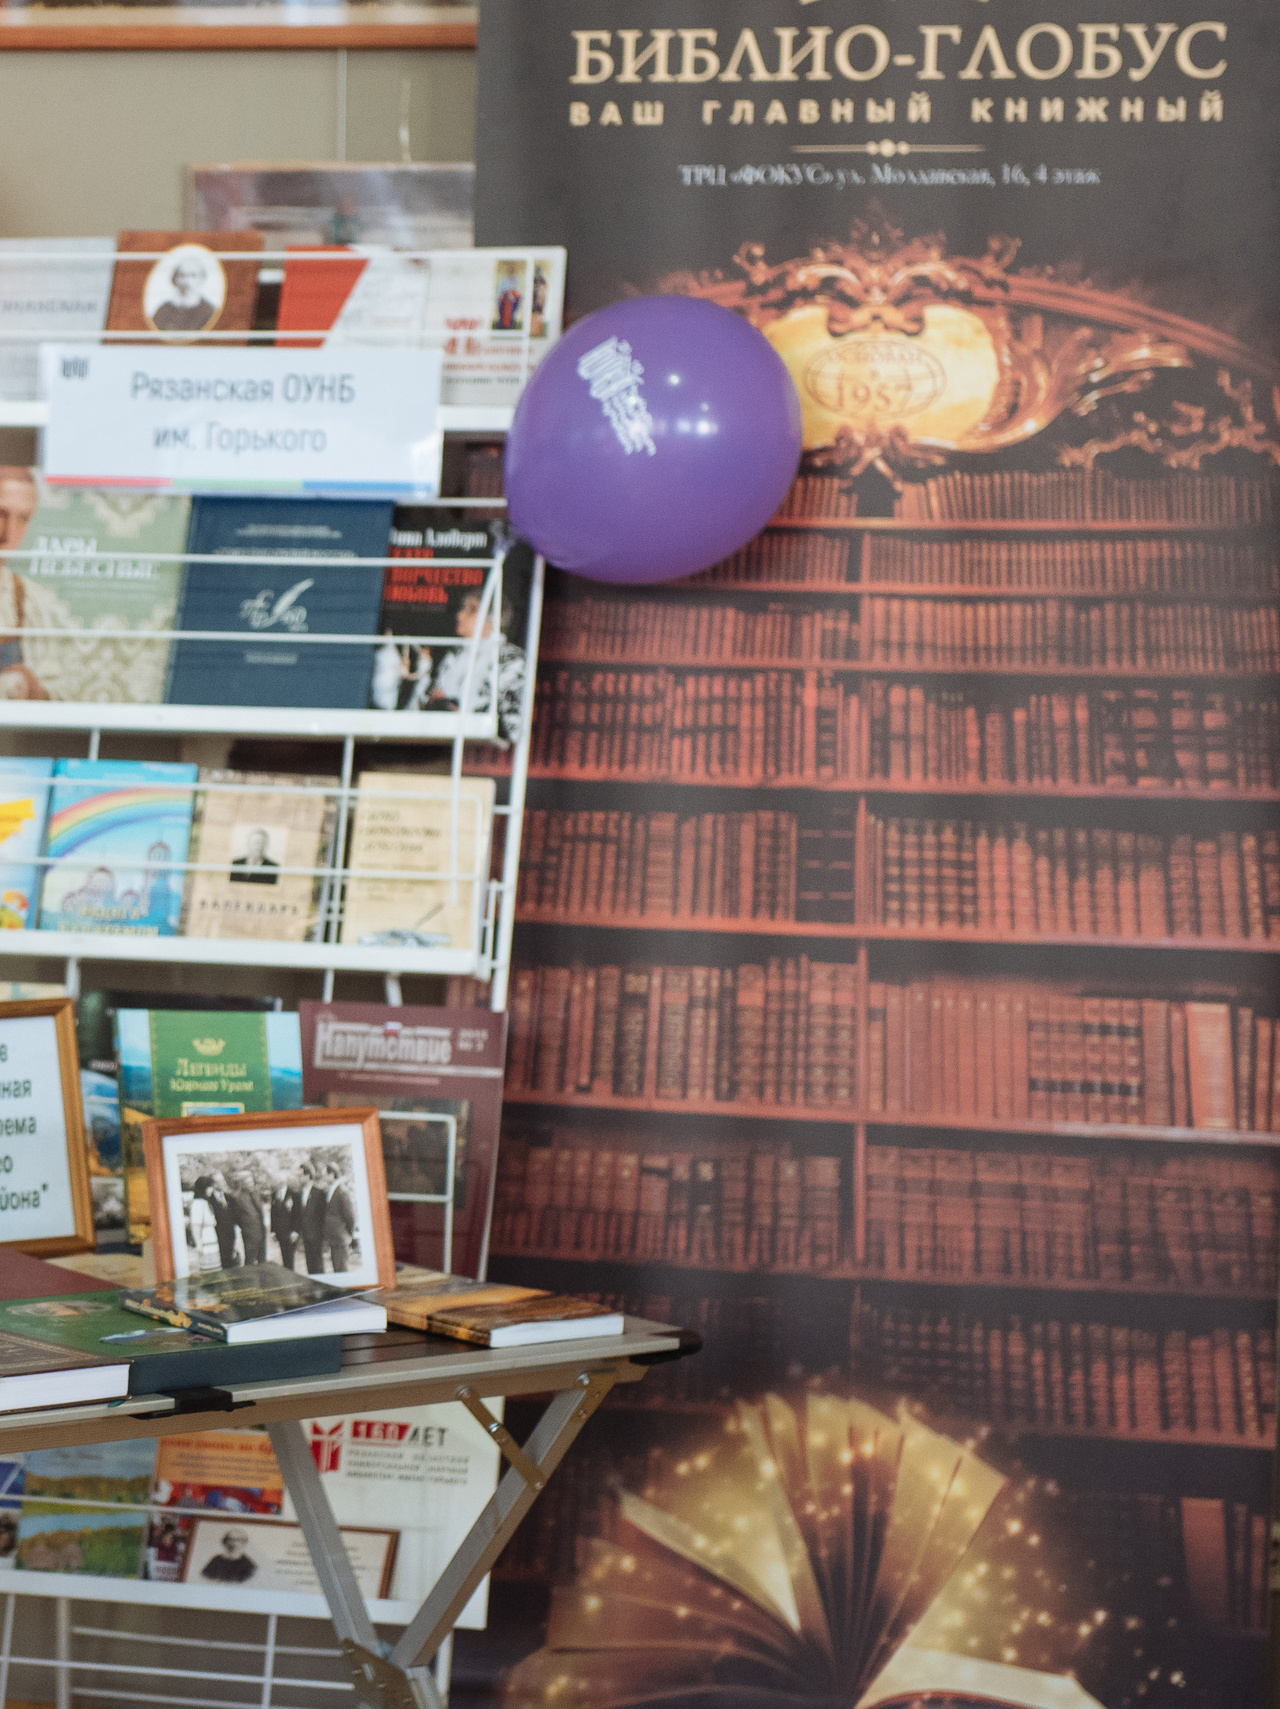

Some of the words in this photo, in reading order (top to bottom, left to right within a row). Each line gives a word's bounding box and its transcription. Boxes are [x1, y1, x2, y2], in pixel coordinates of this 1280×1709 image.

[570, 22, 1228, 84] БИБЛИО-ГЛОБУС
[569, 101, 664, 126] ВАШ
[702, 93, 932, 125] ГЛАВНЫЙ
[972, 91, 1225, 123] КНИЖНЫЙ
[131, 370, 274, 401] Рязанская
[282, 373, 356, 403] ОУНБ
[153, 426, 196, 450] им.
[205, 420, 327, 455] Горького
[409, 1426, 449, 1447] ЛЕТ
